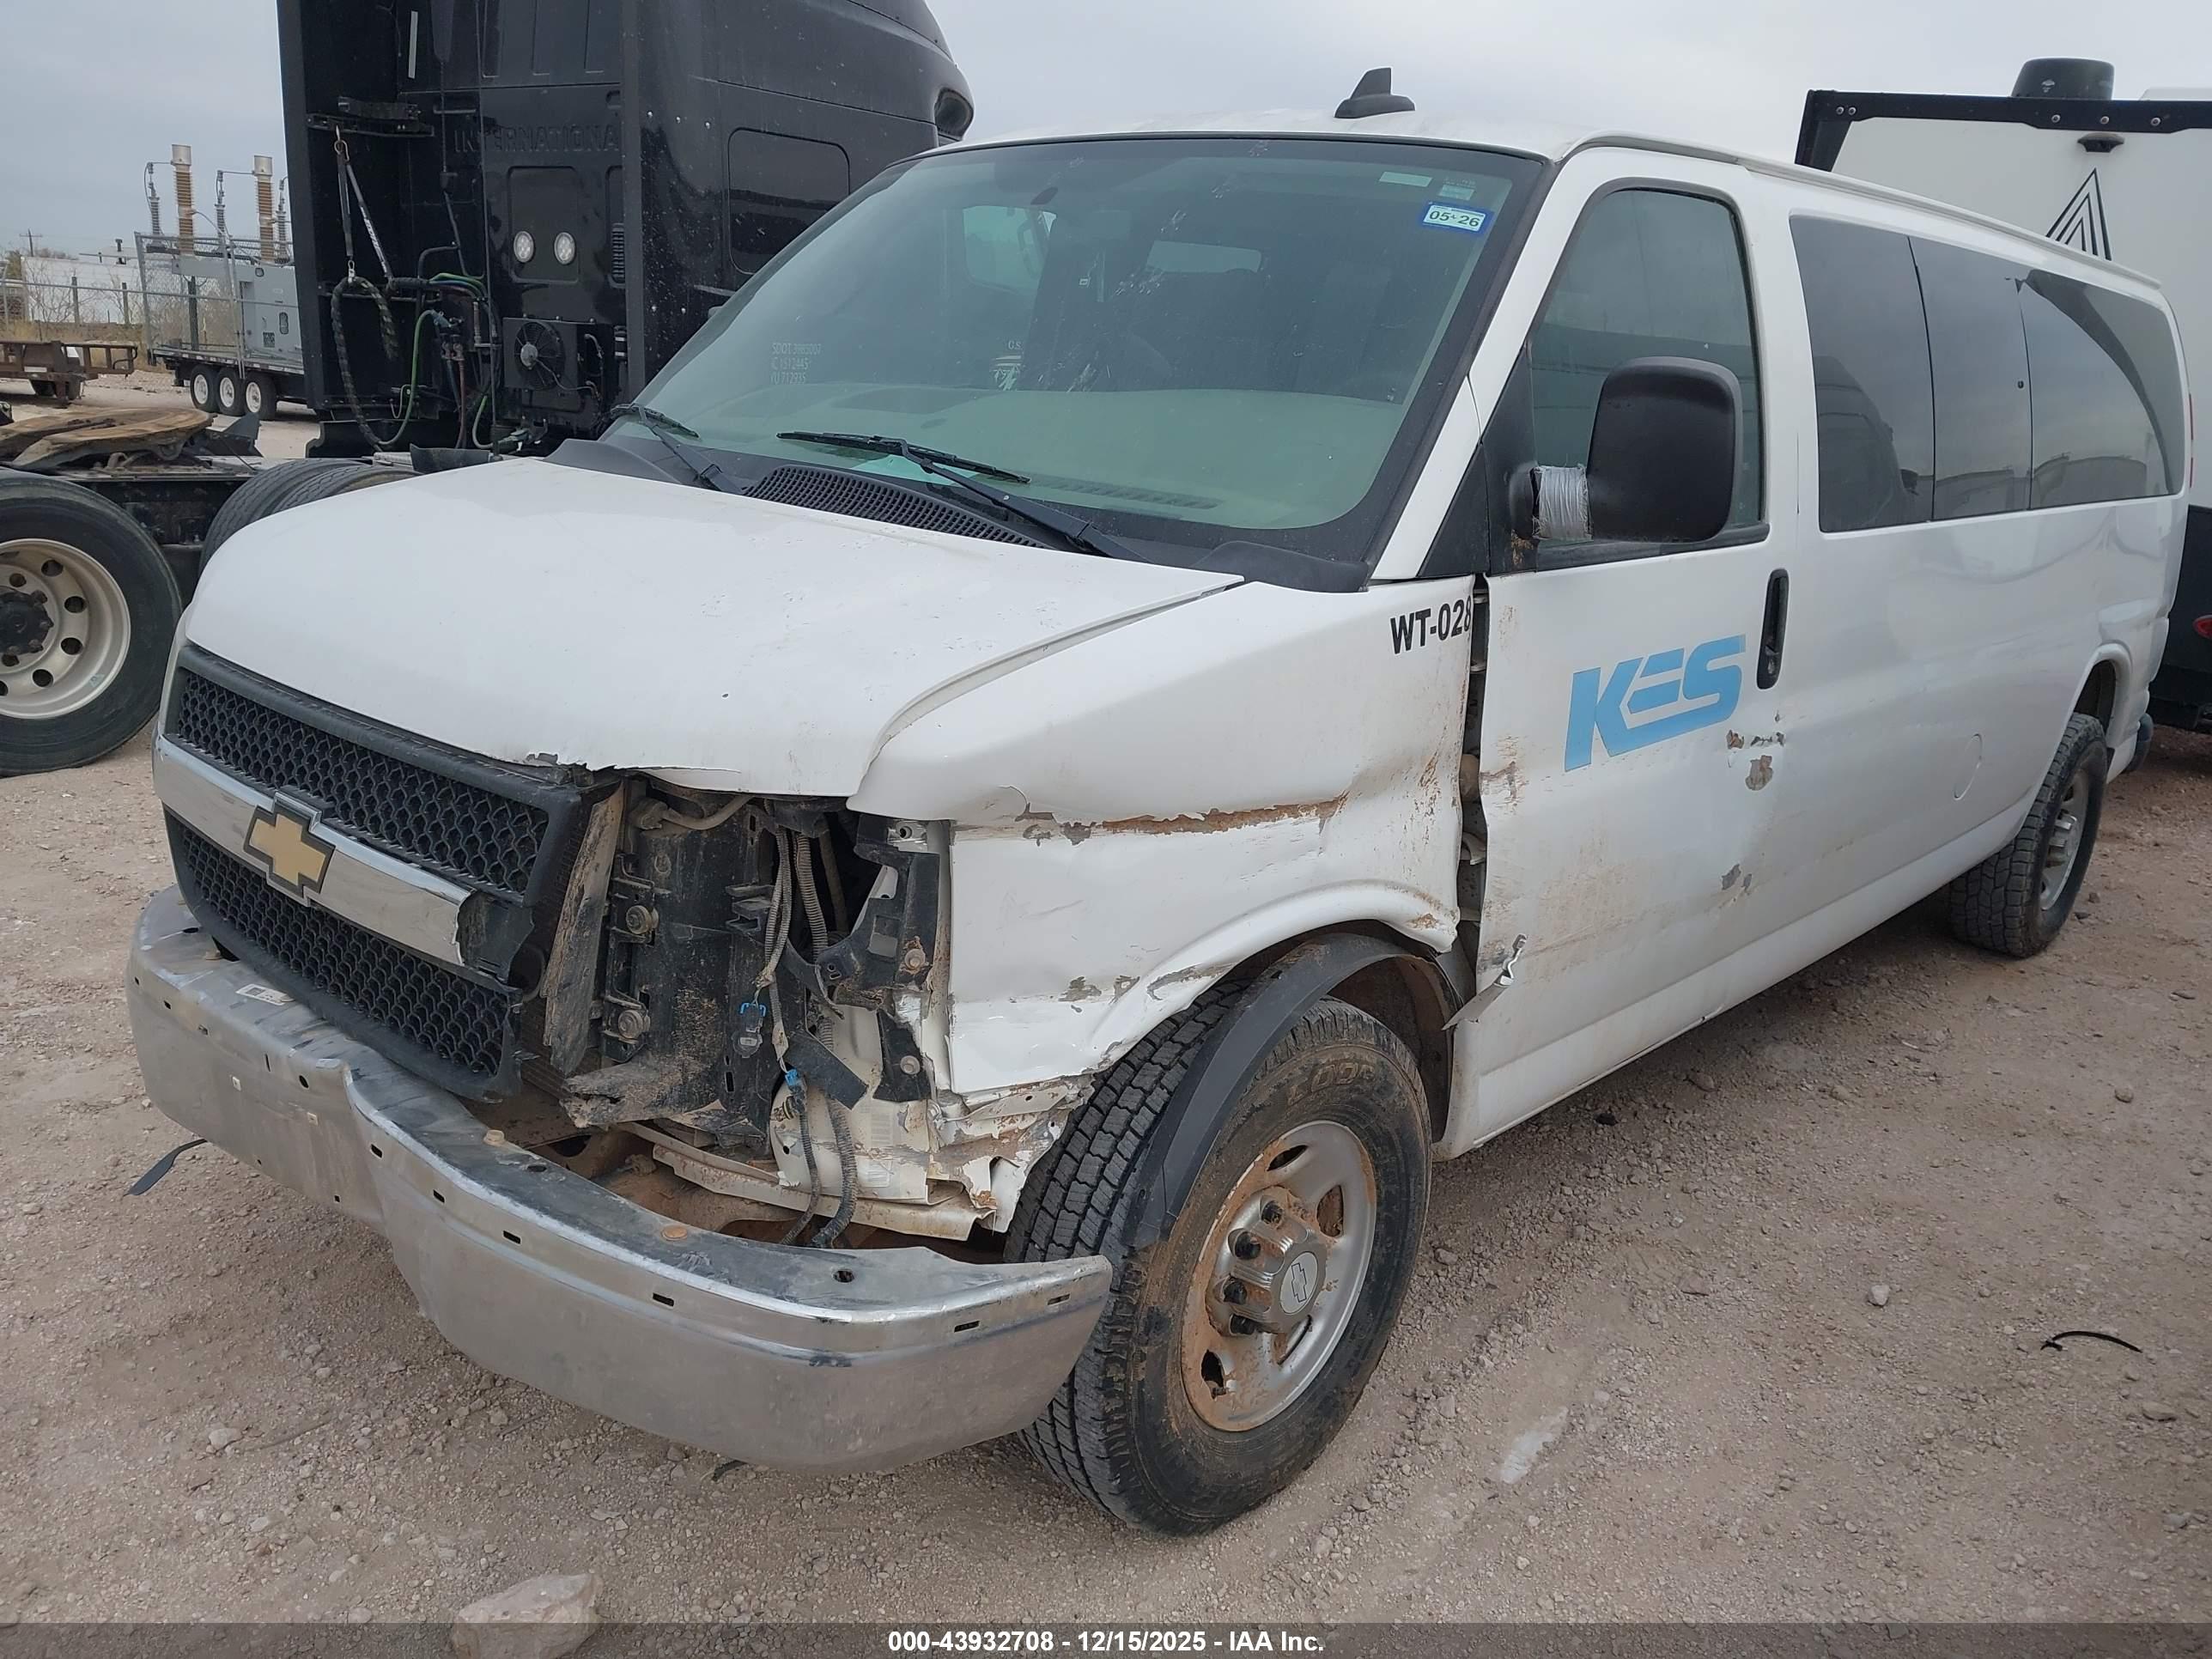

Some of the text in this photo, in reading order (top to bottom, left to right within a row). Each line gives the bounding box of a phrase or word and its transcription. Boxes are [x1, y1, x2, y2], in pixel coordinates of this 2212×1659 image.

[454, 126, 620, 153] INTERNATIONA
[1429, 210, 1451, 222] 05
[1458, 215, 1480, 227] 26
[771, 343, 791, 356] SDOT
[1390, 595, 1471, 654] WT-028
[1565, 634, 1746, 772] KES
